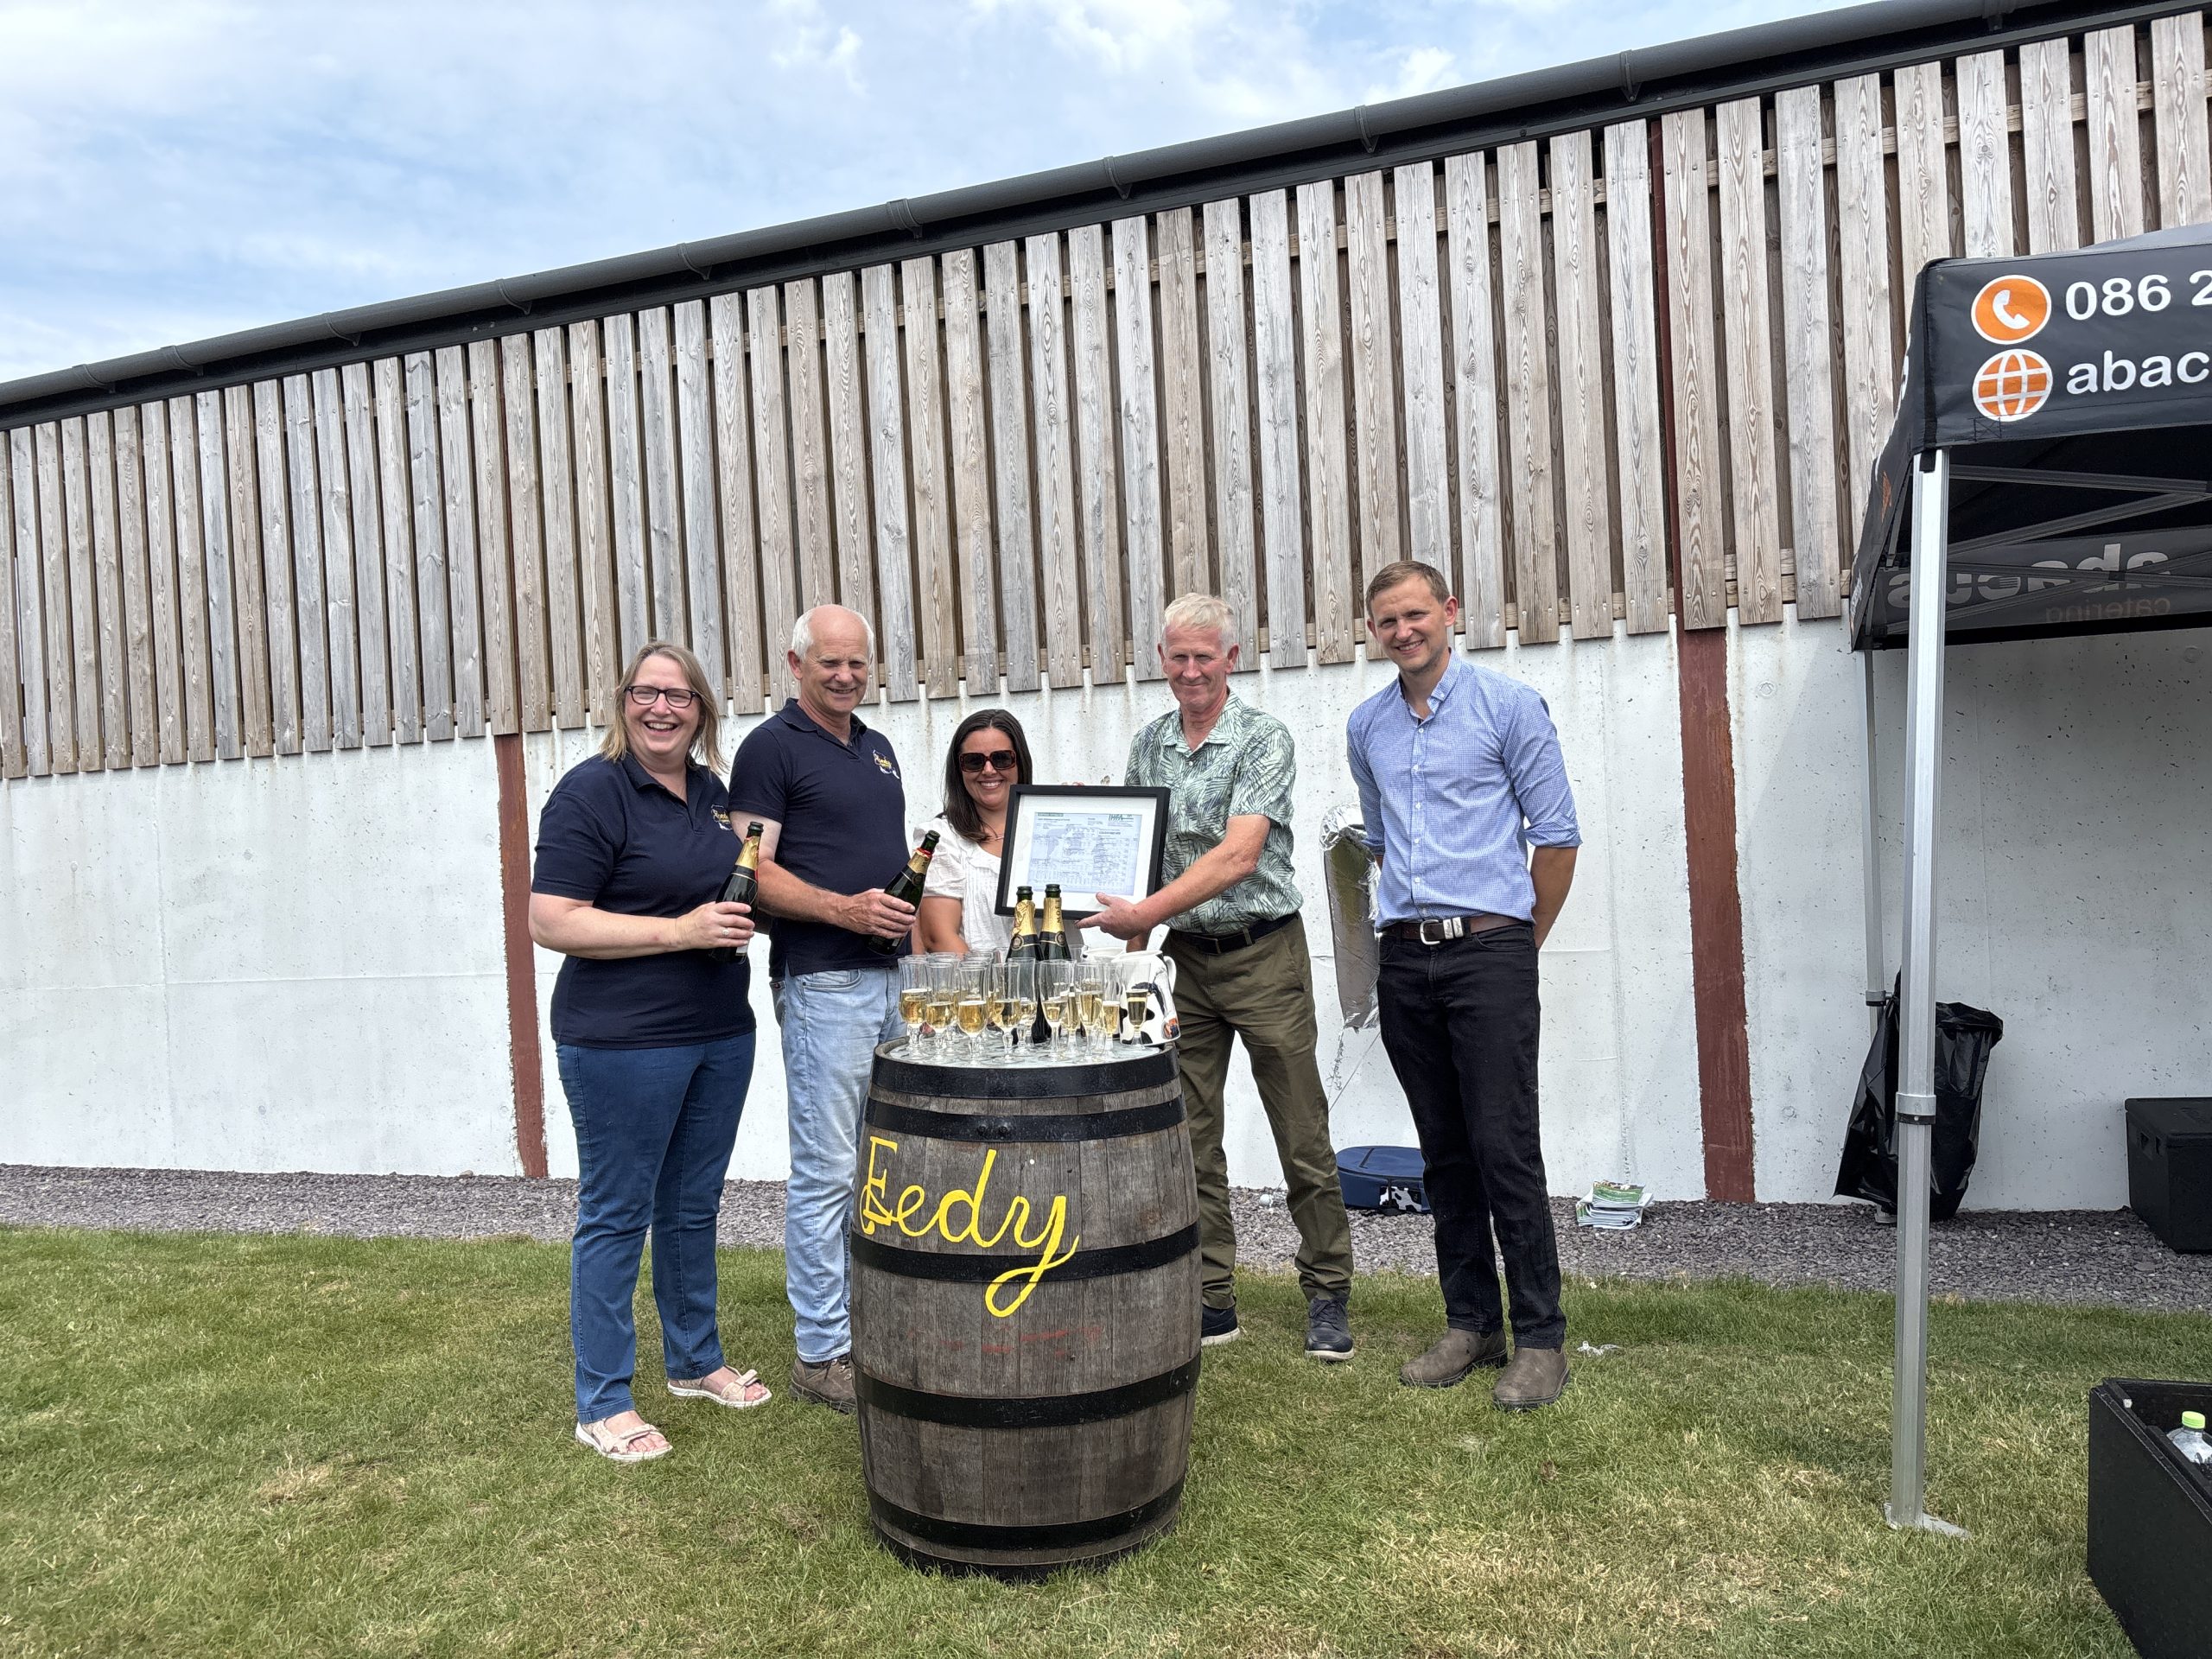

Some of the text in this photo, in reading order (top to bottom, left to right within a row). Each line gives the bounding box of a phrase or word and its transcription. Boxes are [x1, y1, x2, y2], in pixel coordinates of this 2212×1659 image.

[2065, 270, 2212, 321] 086 2
[2066, 350, 2210, 395] abac
